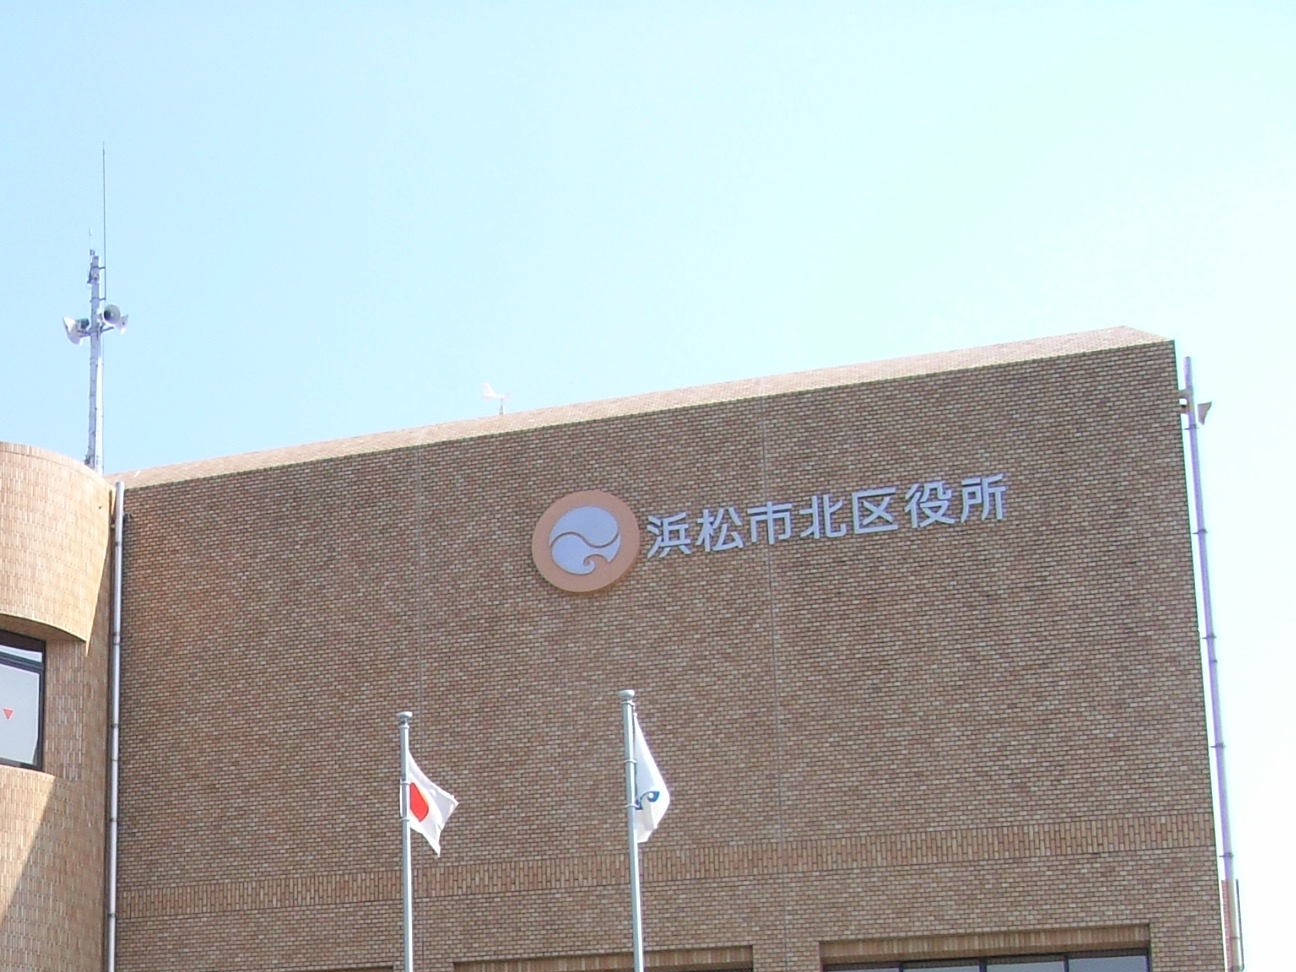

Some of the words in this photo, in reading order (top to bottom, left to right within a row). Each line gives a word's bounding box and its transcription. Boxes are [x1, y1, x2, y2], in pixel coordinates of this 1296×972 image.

[646, 473, 1007, 559] 浜松市北区役所
